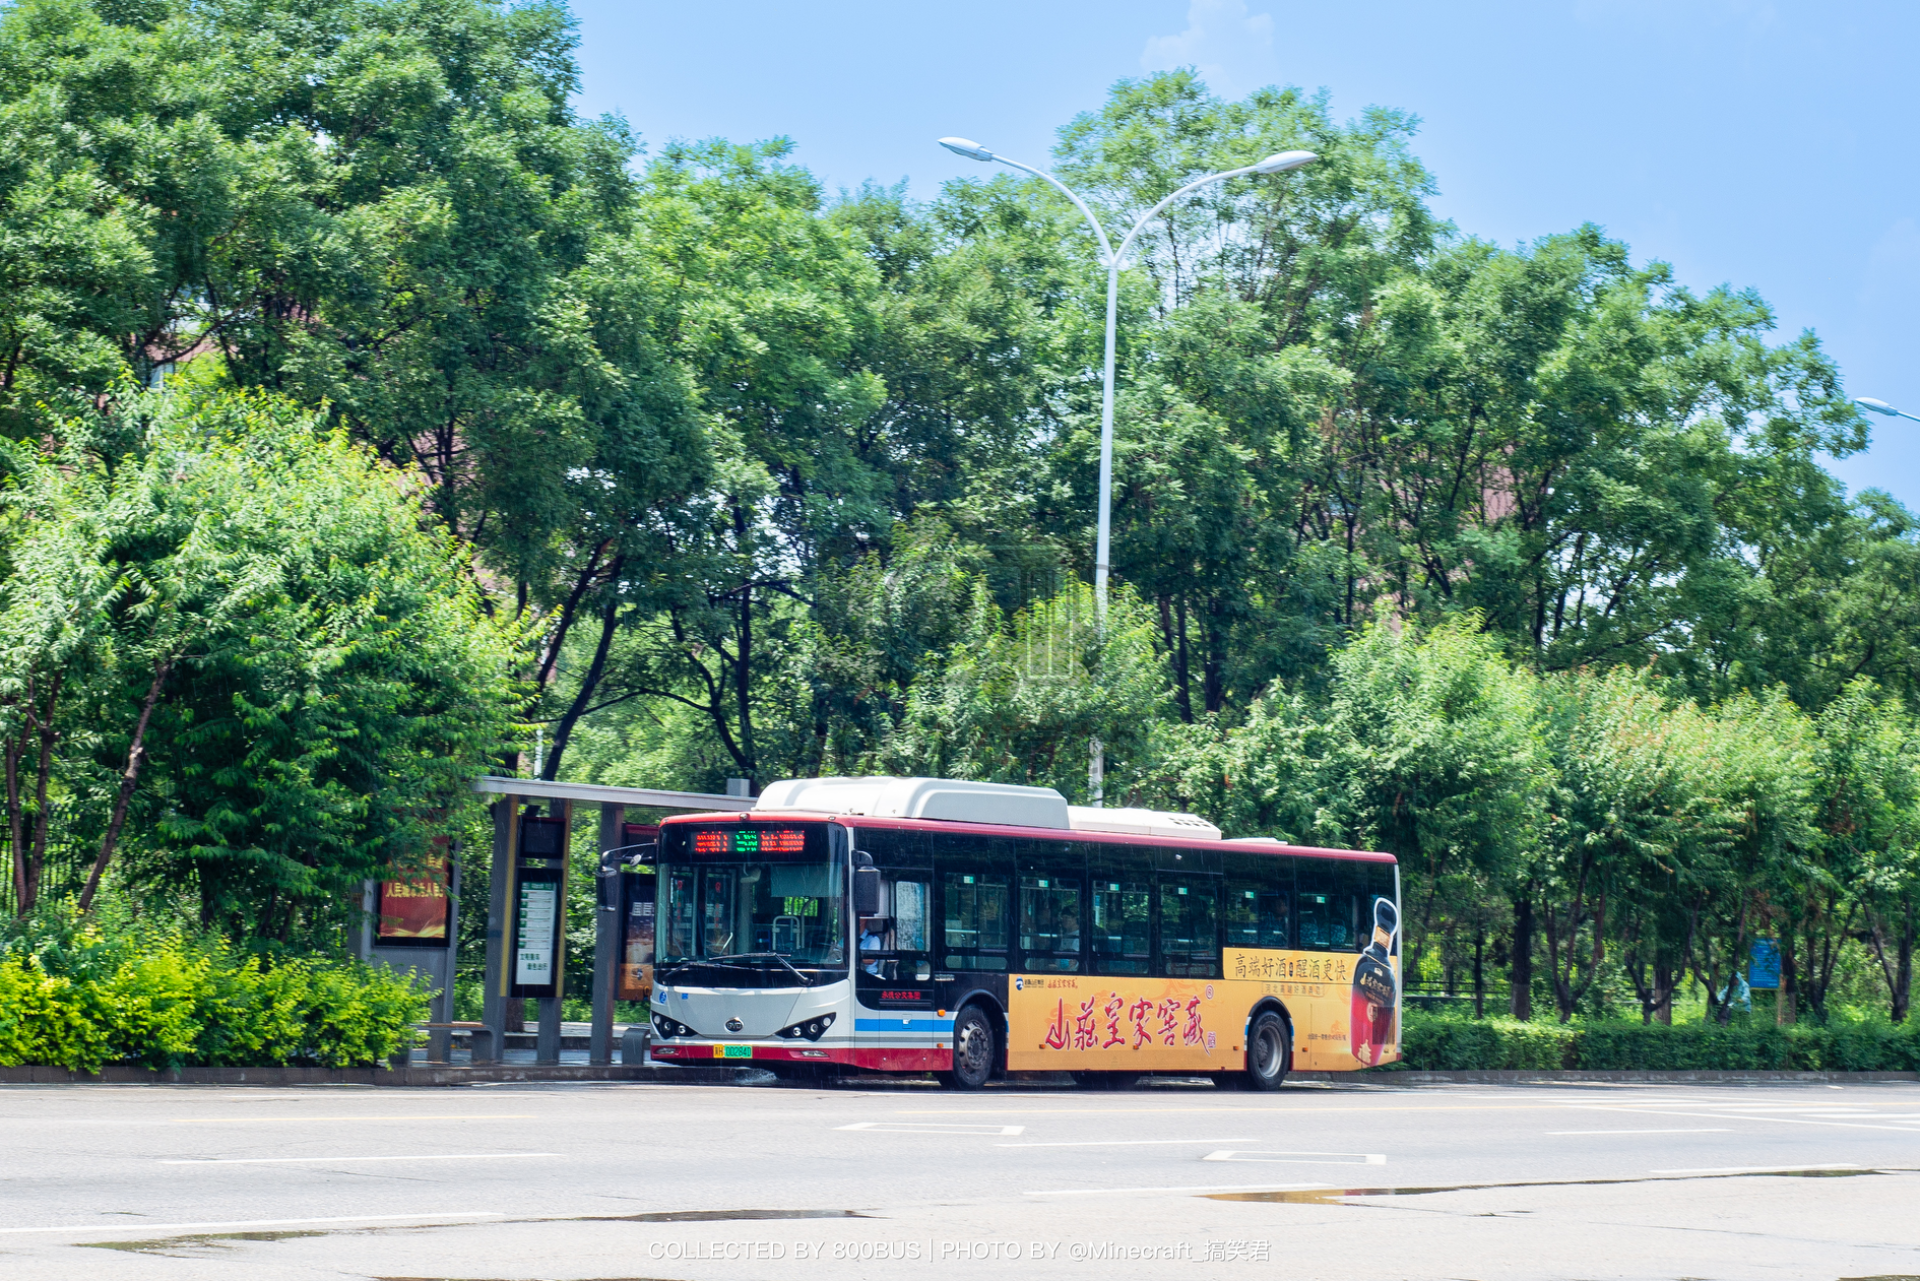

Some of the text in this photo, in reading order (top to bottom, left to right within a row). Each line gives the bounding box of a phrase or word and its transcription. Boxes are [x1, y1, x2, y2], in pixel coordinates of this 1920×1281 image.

[1235, 954, 1287, 979] 高端好酒
[1296, 959, 1347, 981] 醒酒更快
